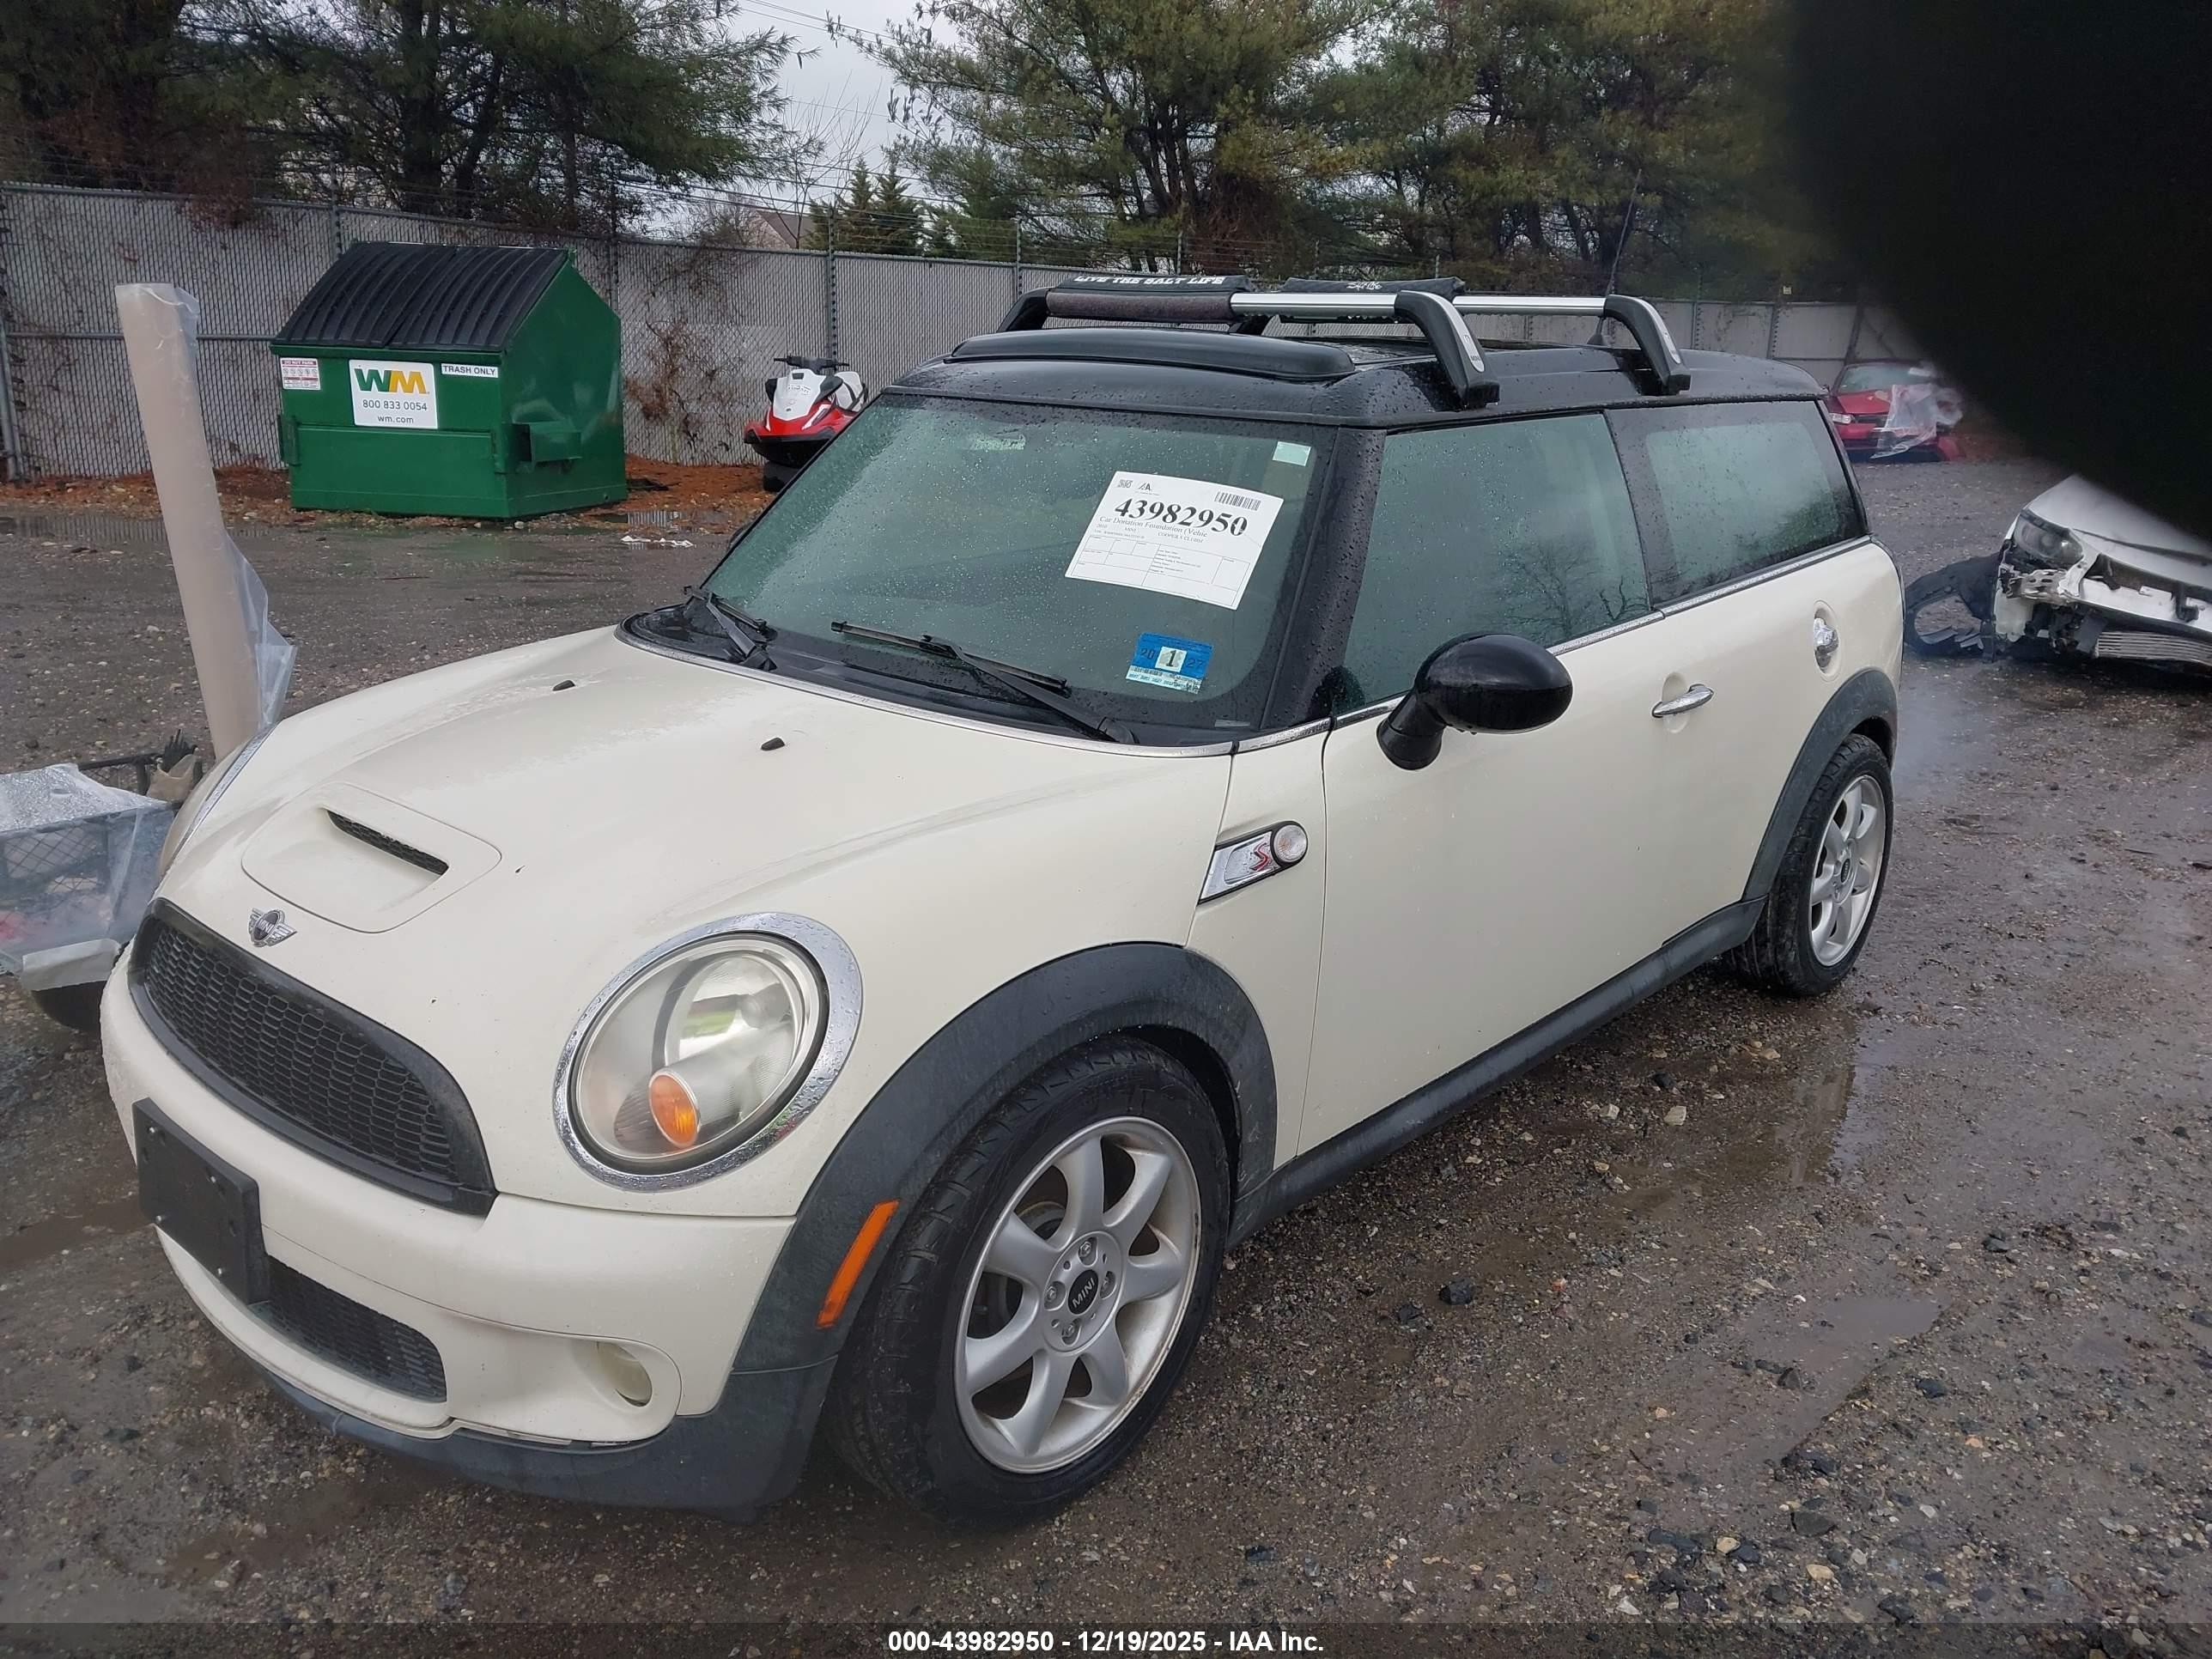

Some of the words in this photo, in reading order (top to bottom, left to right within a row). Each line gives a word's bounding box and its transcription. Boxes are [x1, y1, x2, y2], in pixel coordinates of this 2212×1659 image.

[354, 368, 427, 394] WM
[362, 399, 380, 409] 800
[383, 400, 401, 410] 833
[404, 401, 427, 411] 0054
[1113, 517, 1144, 526] Donation
[1145, 521, 1182, 532] Foundation
[1115, 498, 1248, 537] 43982950
[1165, 650, 1176, 666] 1
[1072, 1278, 1096, 1308] MINI
